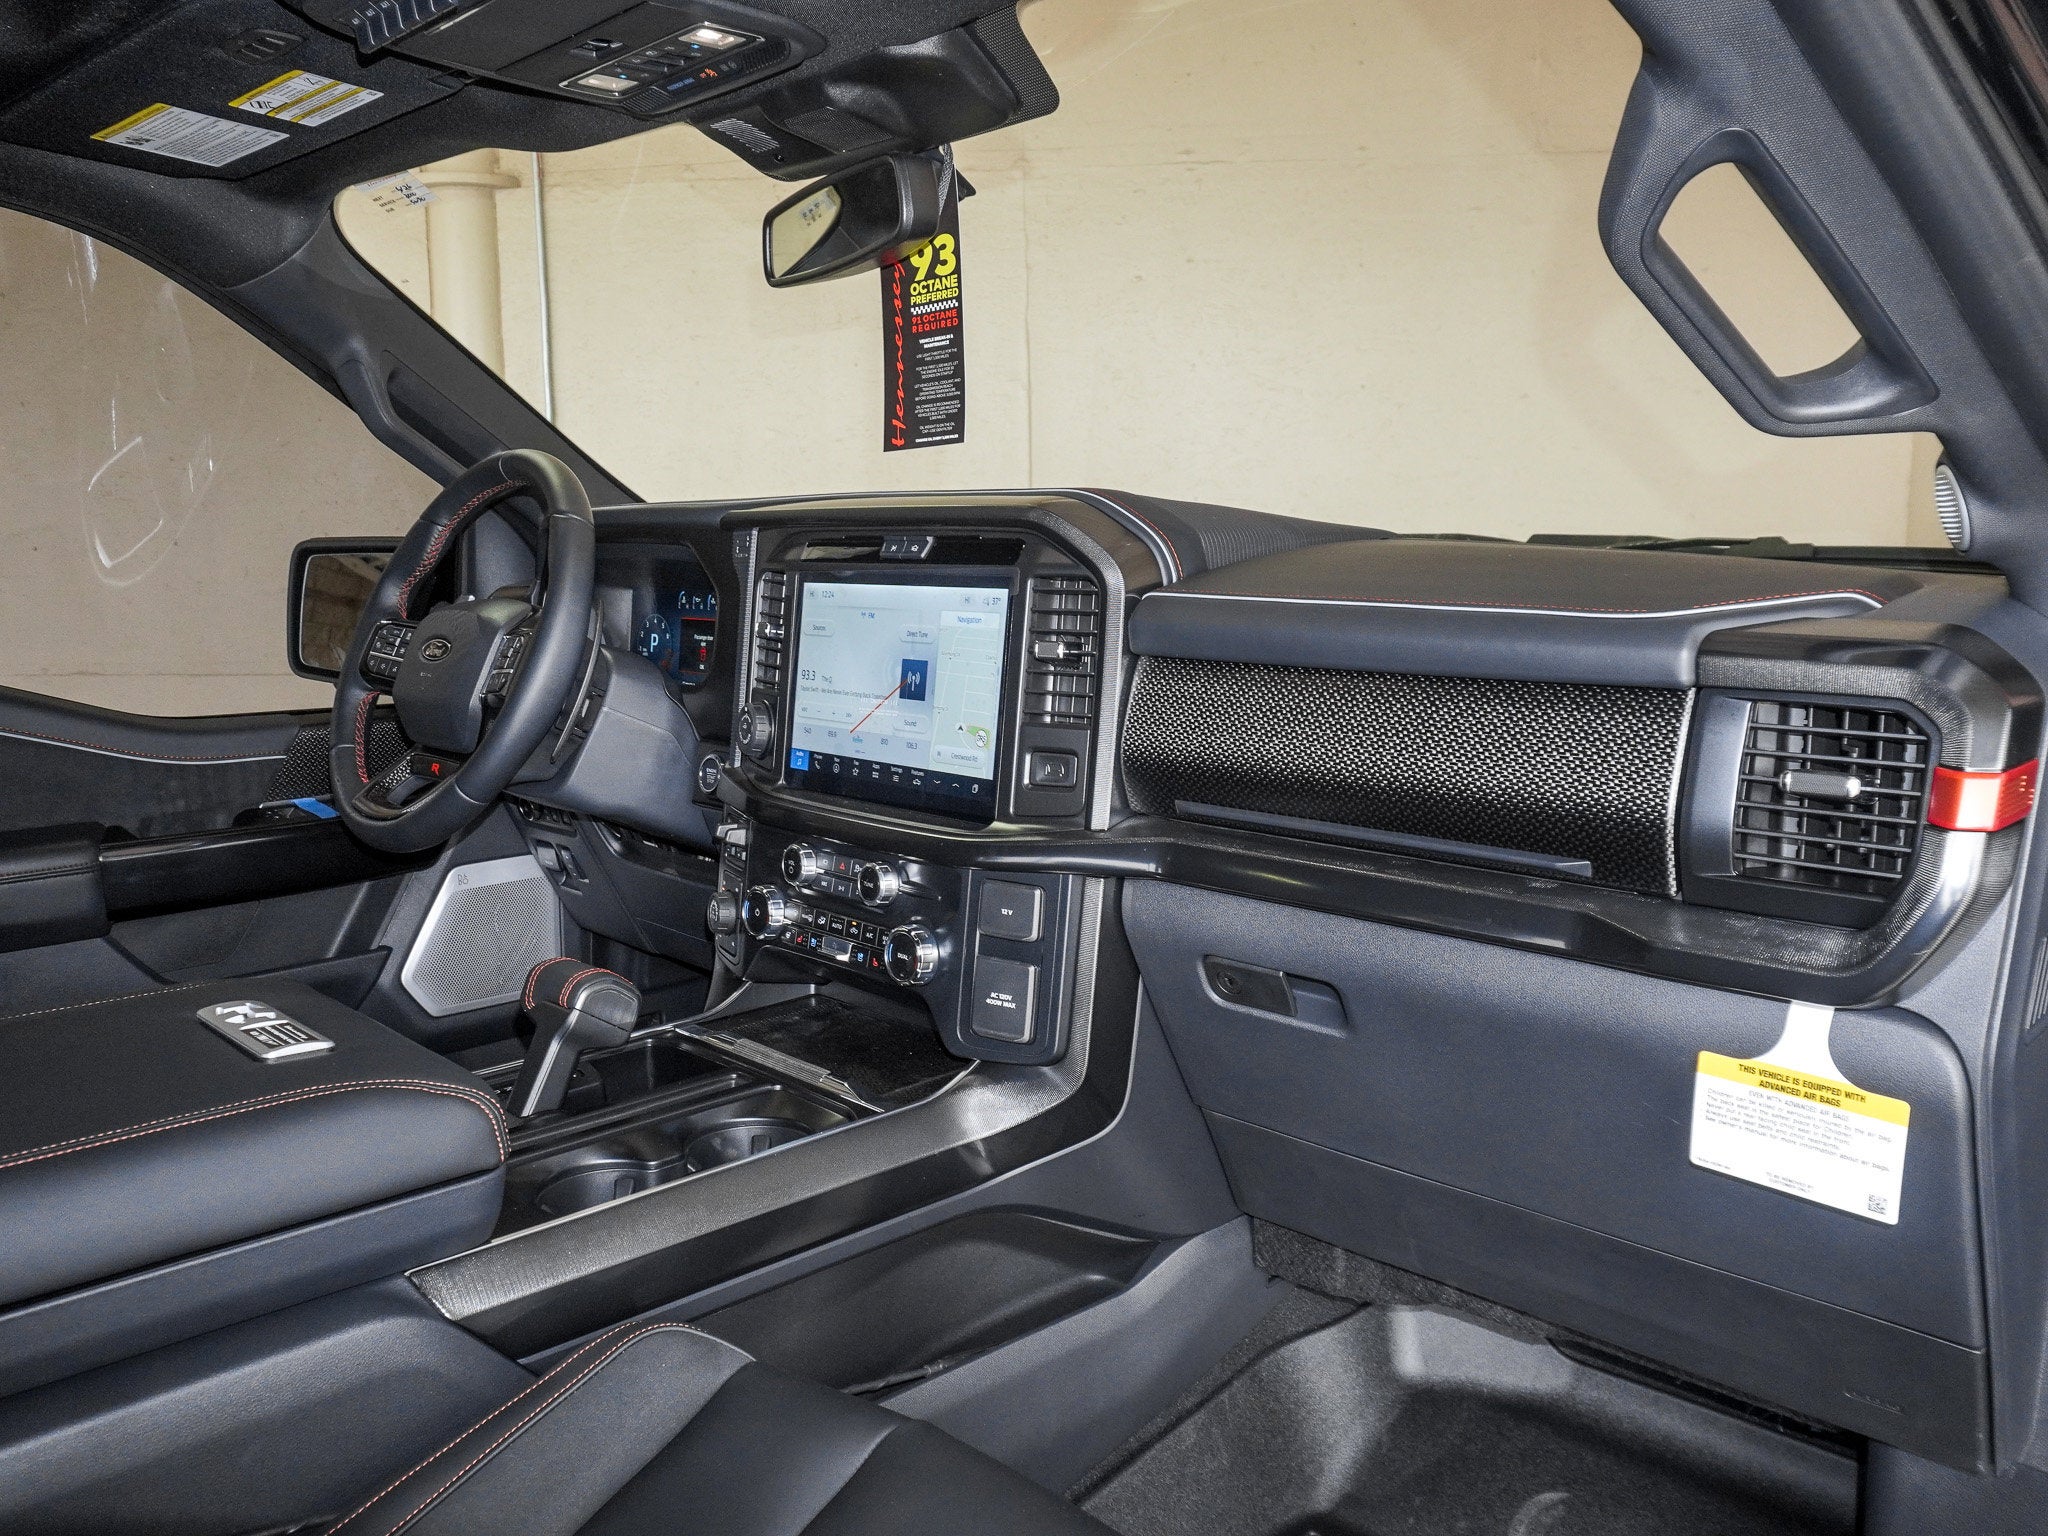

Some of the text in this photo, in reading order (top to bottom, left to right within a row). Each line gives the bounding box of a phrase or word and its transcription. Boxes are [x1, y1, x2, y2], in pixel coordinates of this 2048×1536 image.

[910, 234, 956, 282] 93
[910, 274, 958, 296] OCTANE
[910, 288, 960, 306] PREFERRED
[912, 308, 958, 326] 91 OCTANE
[912, 317, 959, 333] REQUIRED
[957, 616, 982, 624] Navigation
[650, 634, 659, 652] P
[801, 669, 816, 680] 93.3
[431, 763, 440, 776] R
[898, 952, 909, 960] DUAL
[986, 998, 1016, 1009] 400W MAX
[1739, 1064, 1756, 1075] THIS
[1759, 1069, 1791, 1084] VEHICLE
[1803, 1080, 1842, 1096] EQUIPPED
[1845, 1091, 1866, 1103] WITH
[1759, 1080, 1841, 1108] ADVANCED AIR BAGS
